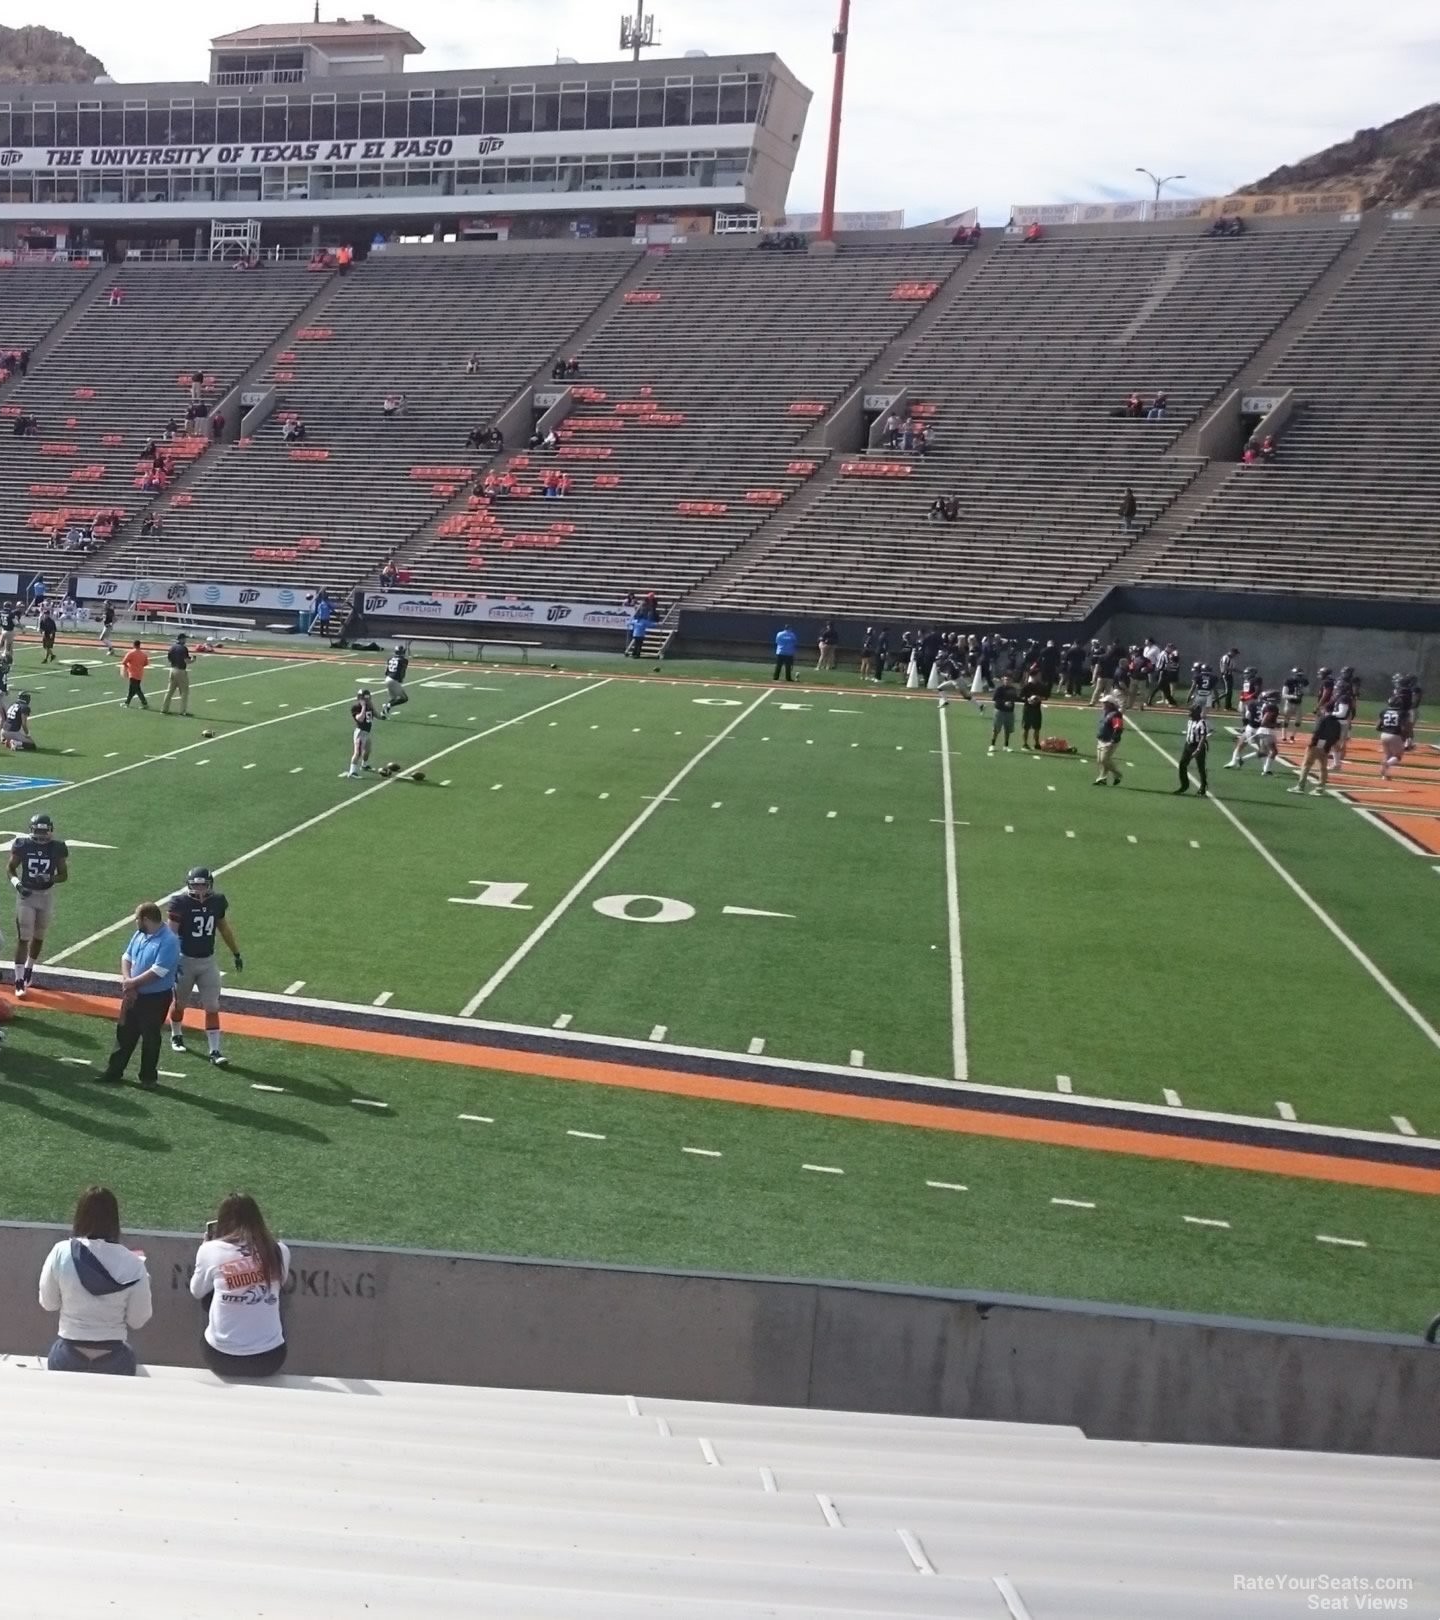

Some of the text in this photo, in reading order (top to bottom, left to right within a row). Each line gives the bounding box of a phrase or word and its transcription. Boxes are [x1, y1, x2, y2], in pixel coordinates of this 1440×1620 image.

[46, 139, 454, 166] THE UNIVERSITY OF TEXAS AT EL PASO
[477, 136, 505, 156] UTEP
[0, 150, 23, 166] UTEP
[98, 580, 118, 597] UTEP
[239, 588, 260, 604] UTEP
[365, 595, 388, 612] UTEP
[454, 599, 478, 617] UTEP
[547, 604, 571, 622] UTEP
[387, 659, 399, 673] 22
[1383, 713, 1399, 726] 23
[27, 858, 51, 878] 57
[191, 915, 215, 938] 34
[226, 1270, 265, 1290] RUIDOS
